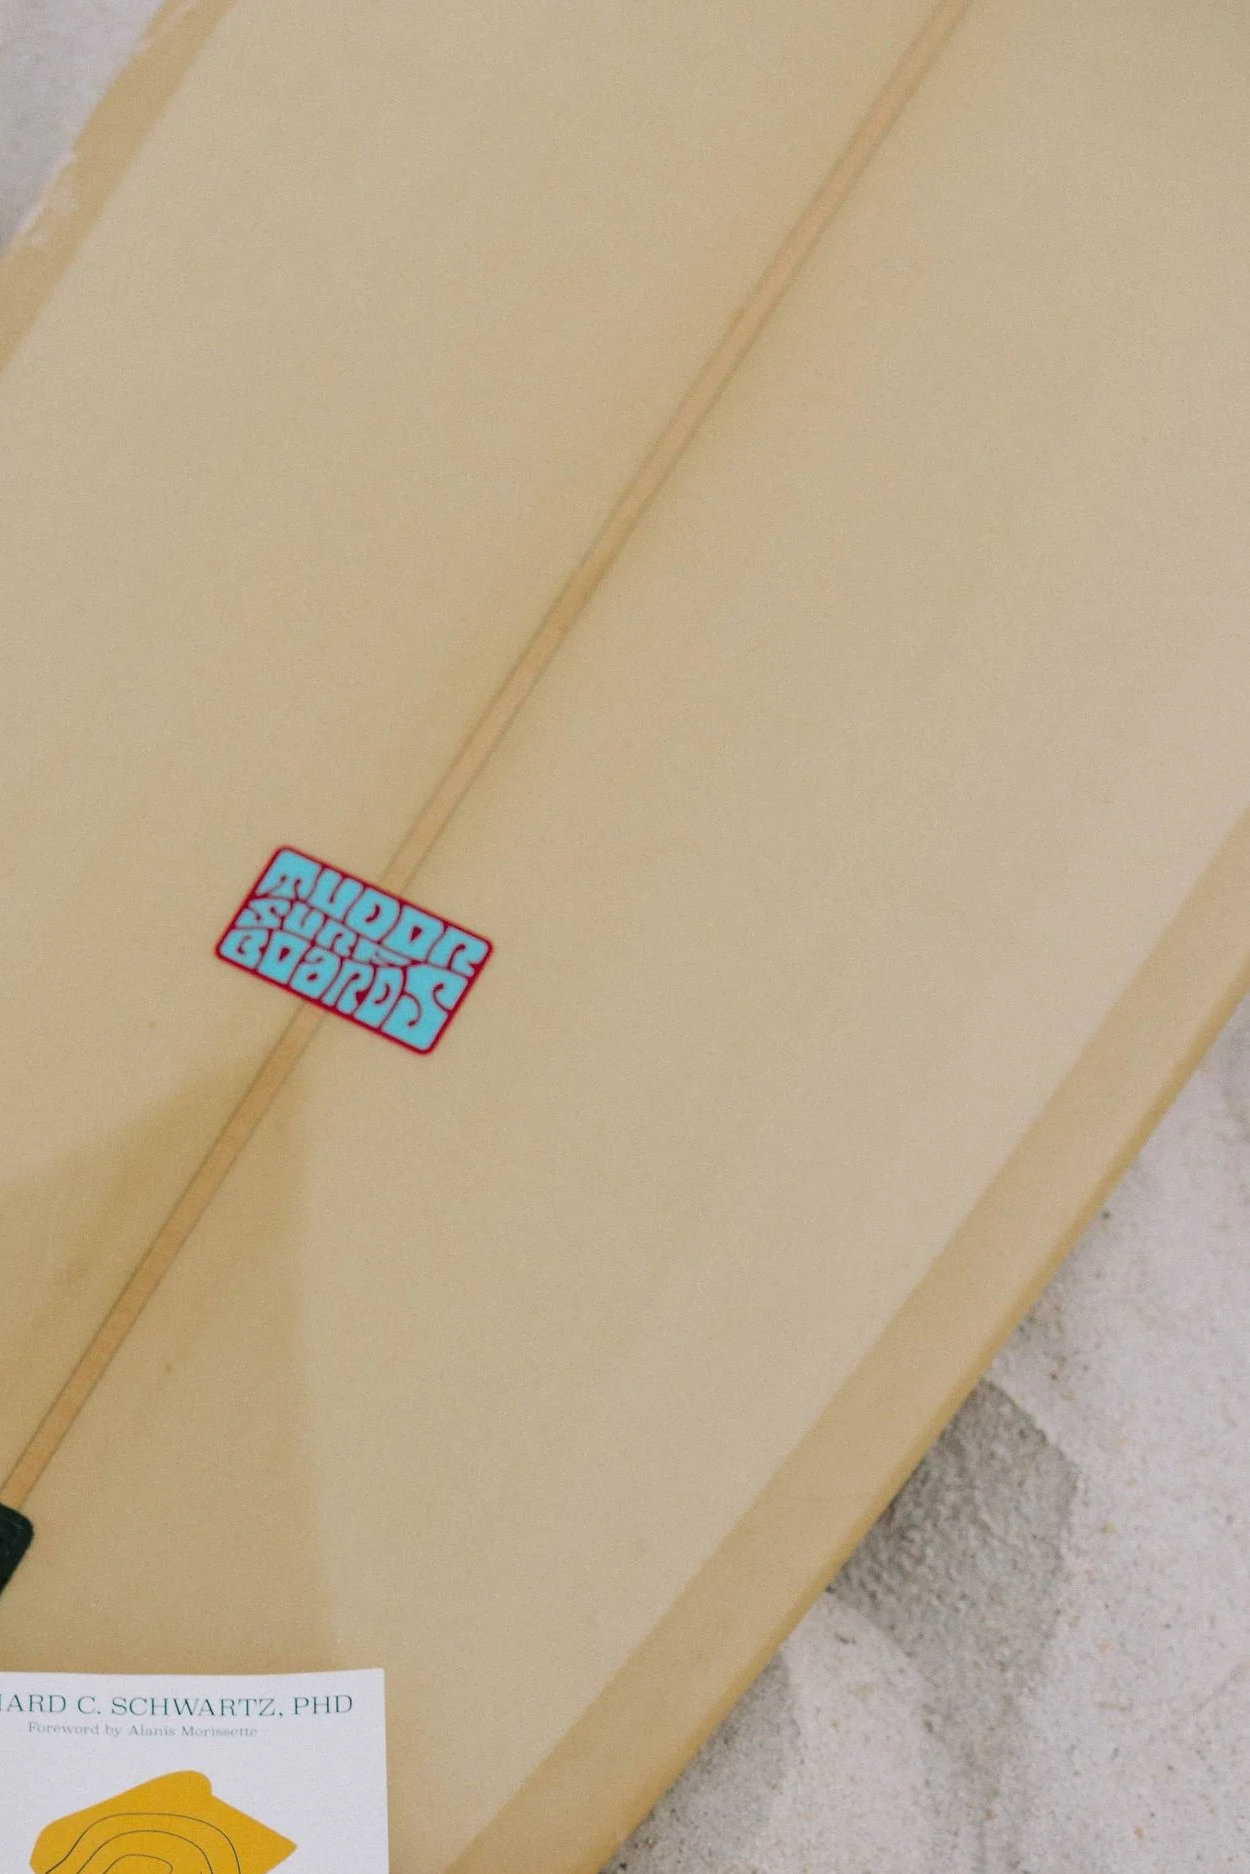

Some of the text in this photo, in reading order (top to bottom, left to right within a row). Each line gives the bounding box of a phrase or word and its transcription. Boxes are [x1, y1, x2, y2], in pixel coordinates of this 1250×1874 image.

[234, 898, 412, 967] SURF
[253, 848, 490, 978] TUDOR
[77, 1695, 101, 1715] C.
[111, 1696, 283, 1718] SCHWARTZ,
[293, 1694, 353, 1715] PHD
[28, 1721, 258, 1738] Foreword by Alanis Morissette
